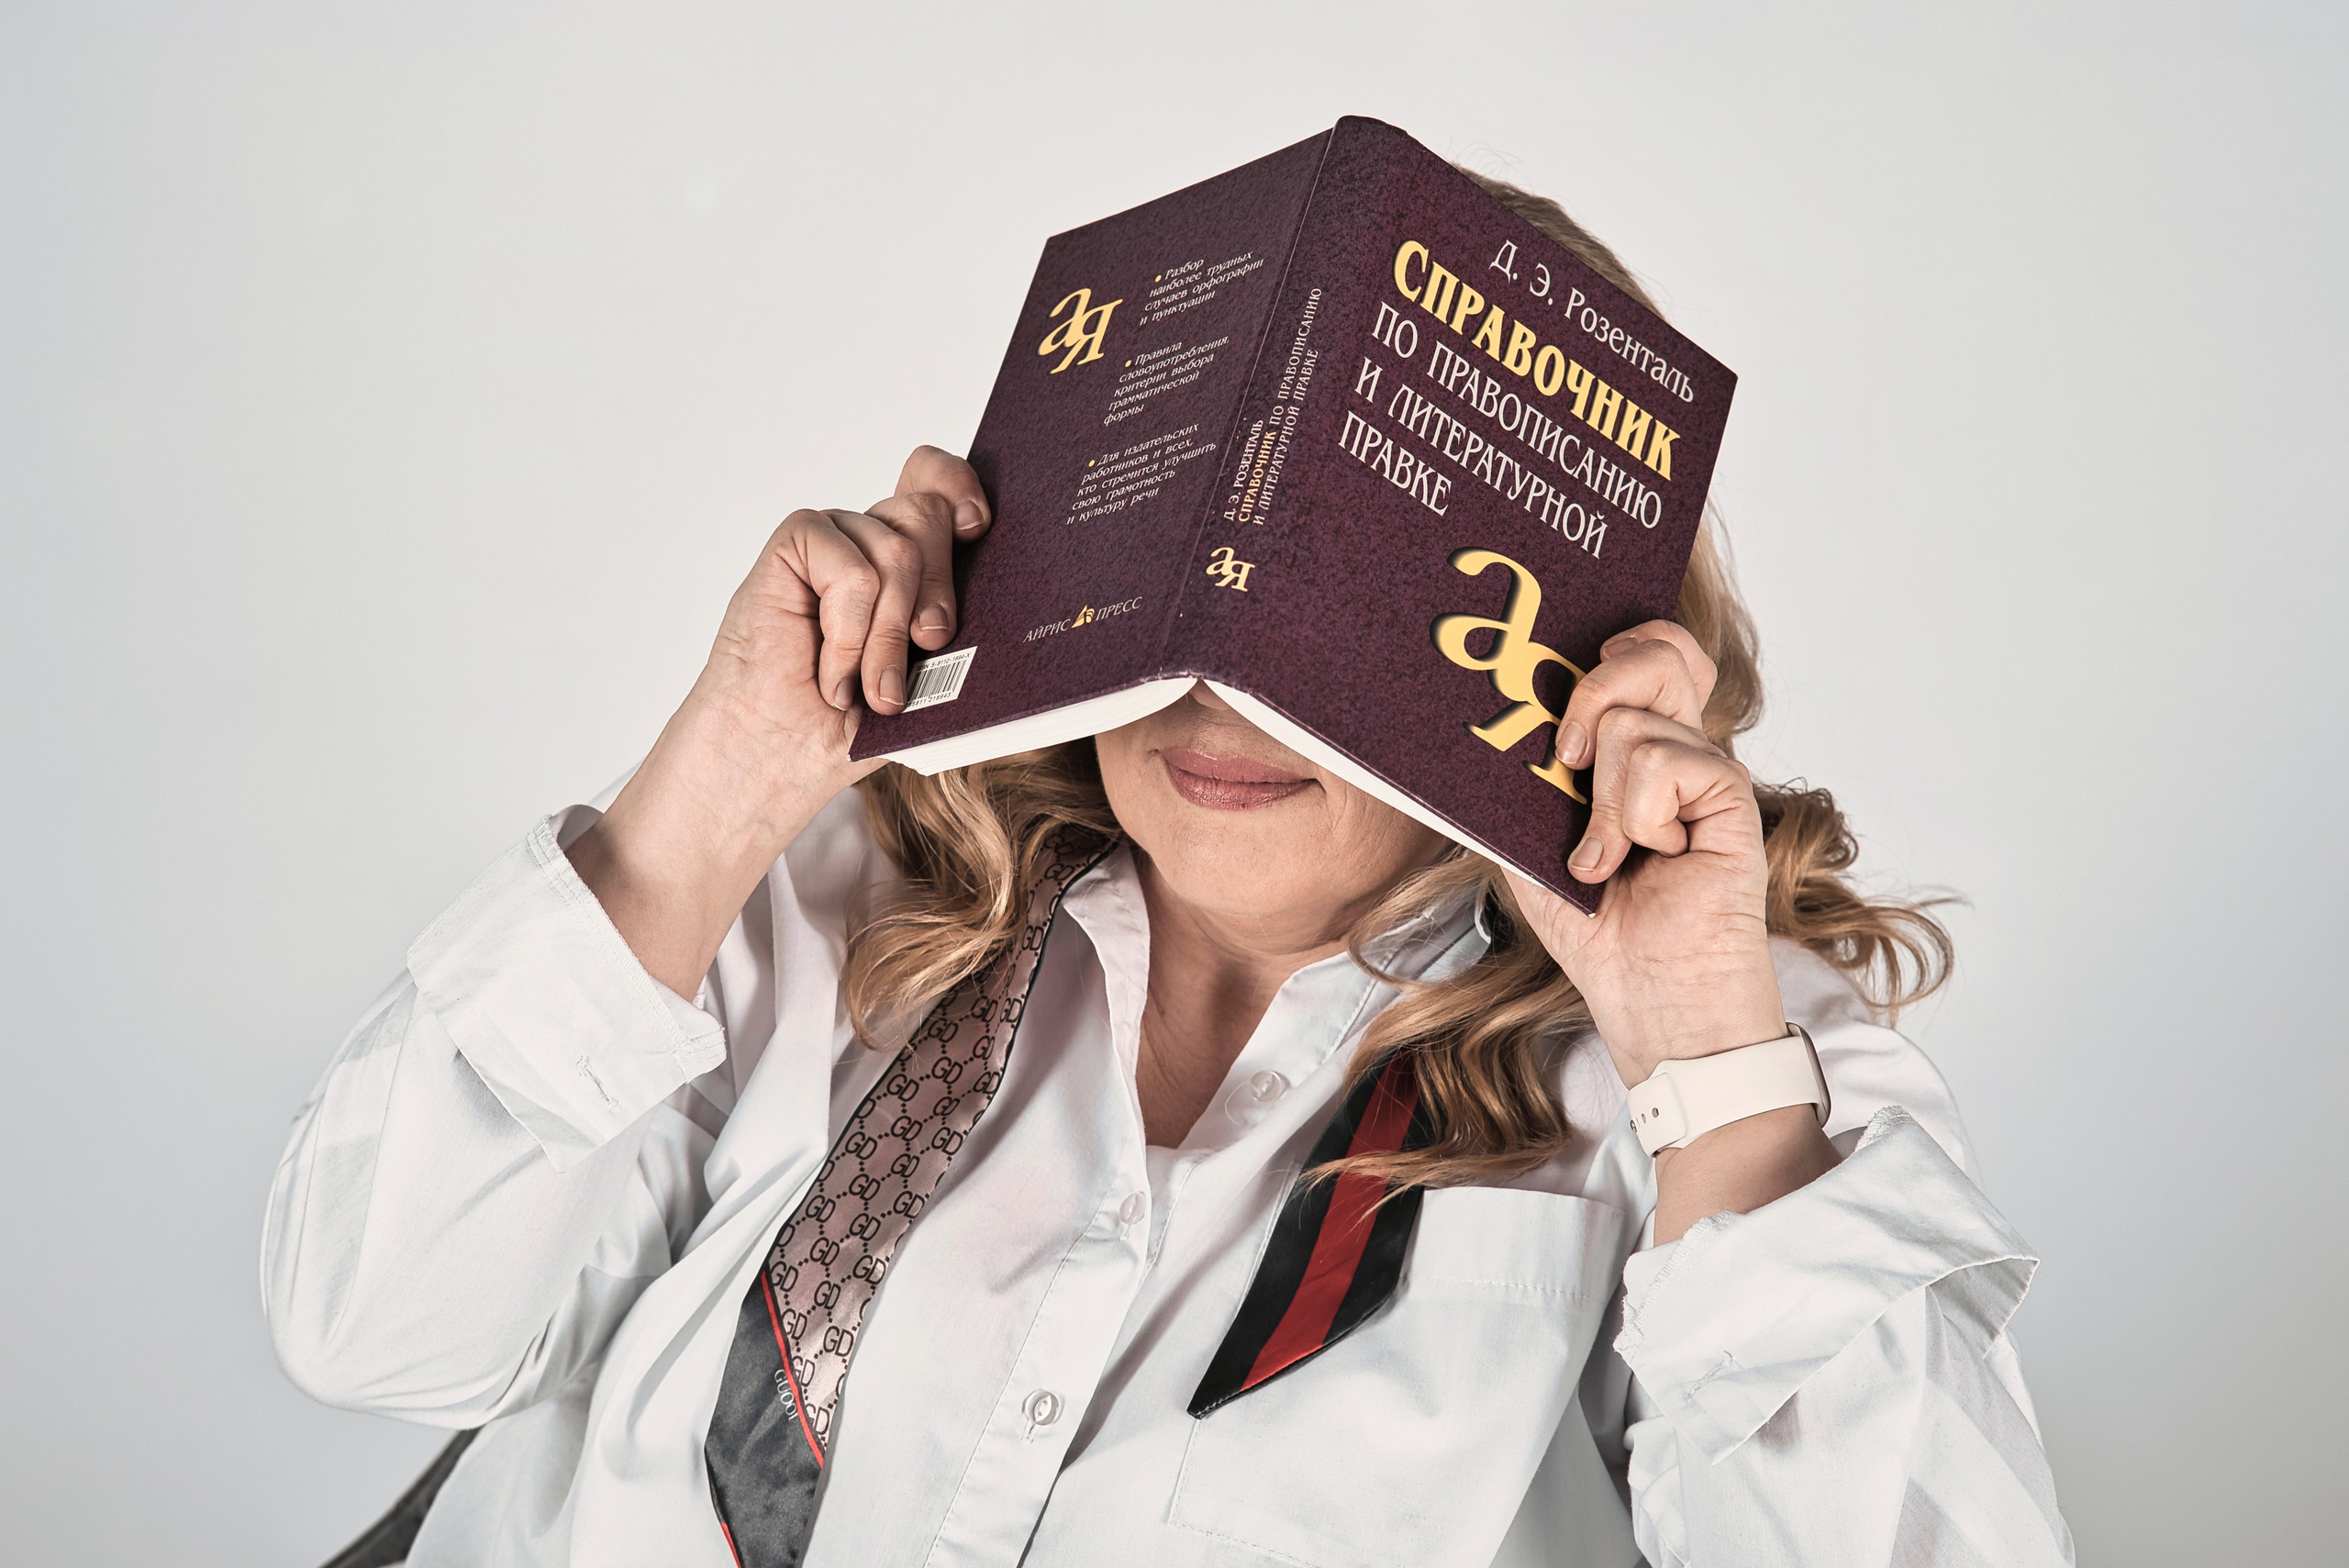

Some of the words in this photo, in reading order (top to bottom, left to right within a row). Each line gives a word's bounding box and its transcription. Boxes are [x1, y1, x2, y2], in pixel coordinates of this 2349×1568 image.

[1144, 289, 1187, 312] случаев
[1192, 259, 1264, 294] орфографии
[1149, 271, 1202, 298] наиболее
[1207, 250, 1253, 276] трудных
[1164, 259, 1204, 281] Разбор
[1140, 316, 1148, 326] и
[1152, 290, 1216, 321] пунктуации
[1488, 239, 1519, 284] Д.
[1529, 262, 1553, 306] Э.
[1564, 287, 1695, 404] Розенталь
[1119, 336, 1230, 384] словоупотребления,
[1134, 341, 1182, 365] Правила
[1276, 287, 1322, 400] ПРАВОПИСАНИЮ
[1393, 239, 1681, 482] СПРАВОЧНИК
[1108, 370, 1200, 412] грамматической
[1113, 372, 1167, 397] критерии
[1171, 353, 1214, 377] выбора
[1293, 349, 1319, 402] ПРАВКЕ
[1103, 404, 1144, 427] формы
[1269, 405, 1285, 426] ПО
[1372, 301, 1419, 358] ПО
[1427, 340, 1662, 528] ПРАВОПИСАНИЮ
[1081, 454, 1149, 485] работников
[1152, 449, 1162, 460] и
[1164, 438, 1194, 455] всех,
[1097, 452, 1120, 467] Для
[1124, 423, 1199, 457] издательских
[1233, 418, 1264, 488] РОЗЕНТАЛЬ
[1257, 406, 1300, 511] ЛИТЕРАТУРНОЙ
[1338, 410, 1452, 517] ПРАВКЕ
[1354, 357, 1383, 404] И
[1388, 384, 1608, 559] ЛИТЕРАТУРНОЙ
[1072, 495, 1101, 511] свою
[1106, 470, 1175, 500] грамотность
[1076, 484, 1097, 497] кто
[1102, 462, 1159, 489] стремится
[1162, 442, 1217, 470] улучшить
[1238, 430, 1277, 523] СПРАВОЧНИК
[1066, 516, 1075, 526] и
[1078, 497, 1128, 522] культуру
[1130, 486, 1160, 507] речи
[1223, 507, 1237, 521] Д.
[1228, 491, 1241, 505] Э.
[1252, 516, 1265, 527] И
[1022, 618, 1071, 643] АЙРИС
[1095, 596, 1142, 622] ПРЕСС
